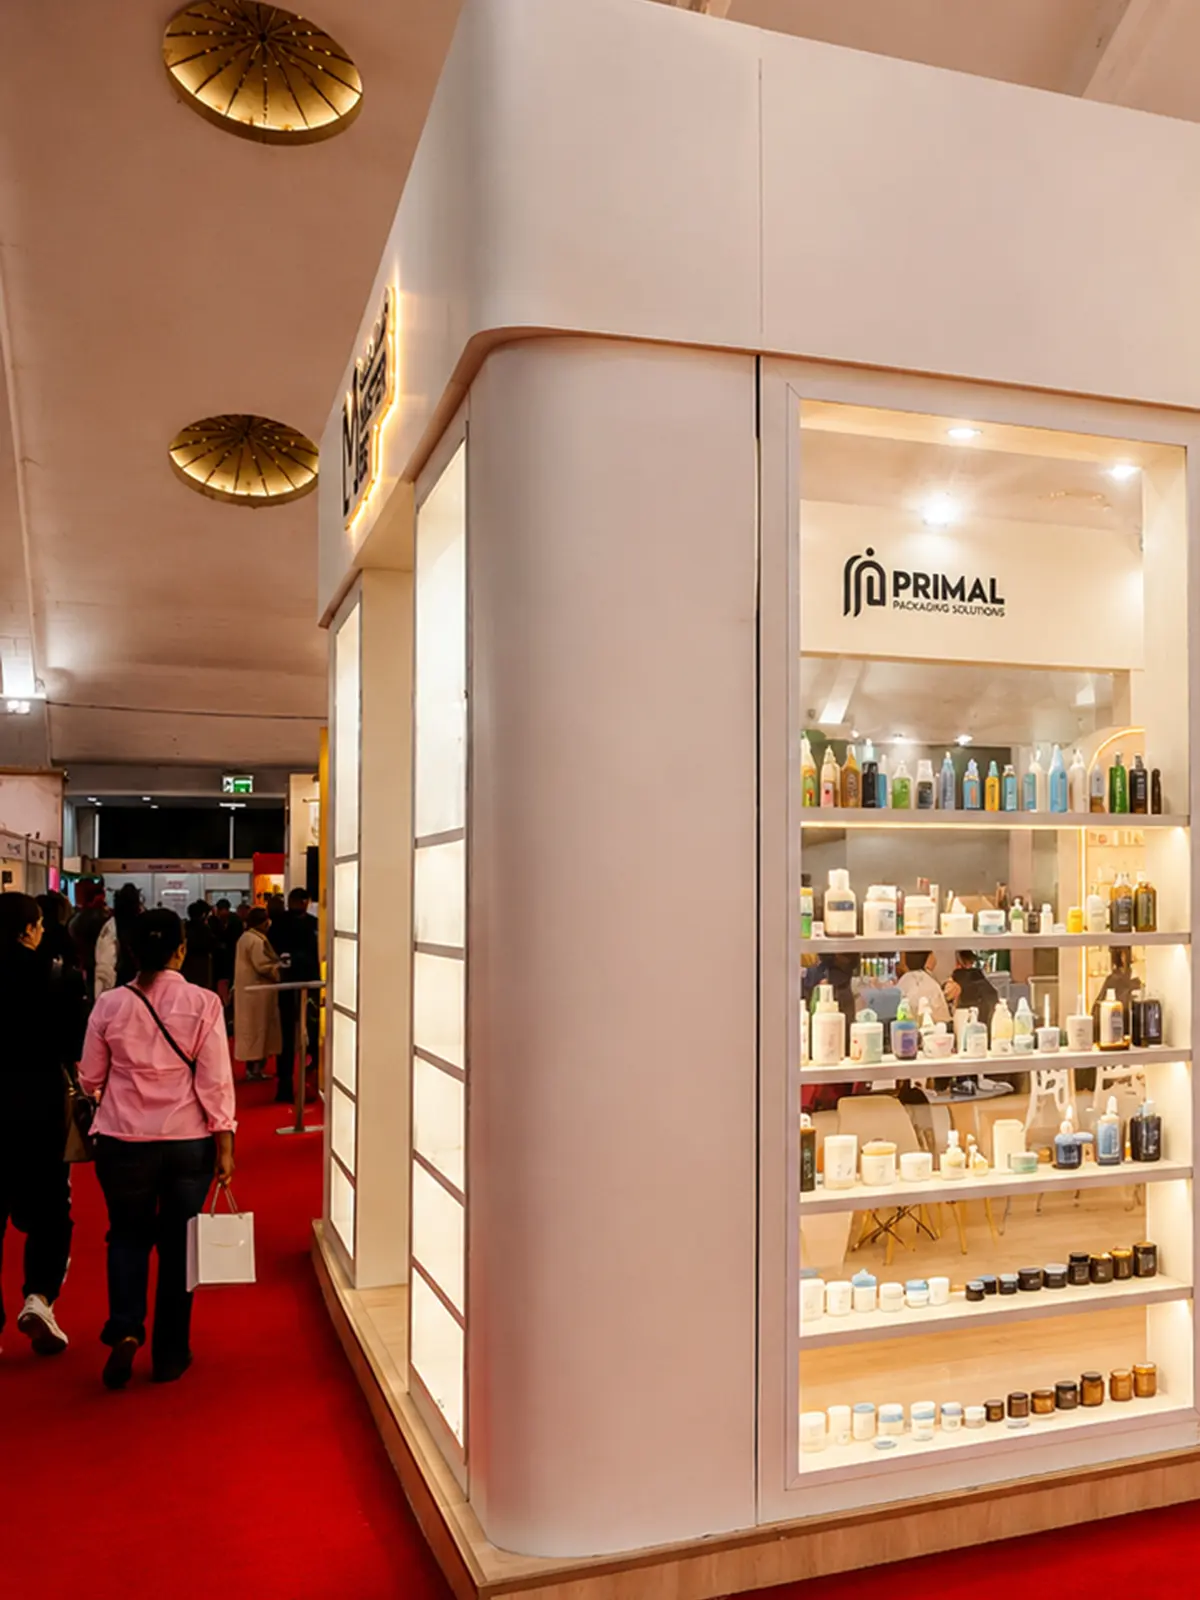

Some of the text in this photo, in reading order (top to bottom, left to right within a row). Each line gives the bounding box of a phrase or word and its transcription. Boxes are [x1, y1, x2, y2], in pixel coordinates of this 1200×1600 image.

[892, 570, 1006, 605] PRIMAL
[892, 600, 1006, 618] PACKAGING SOLUTIONS
